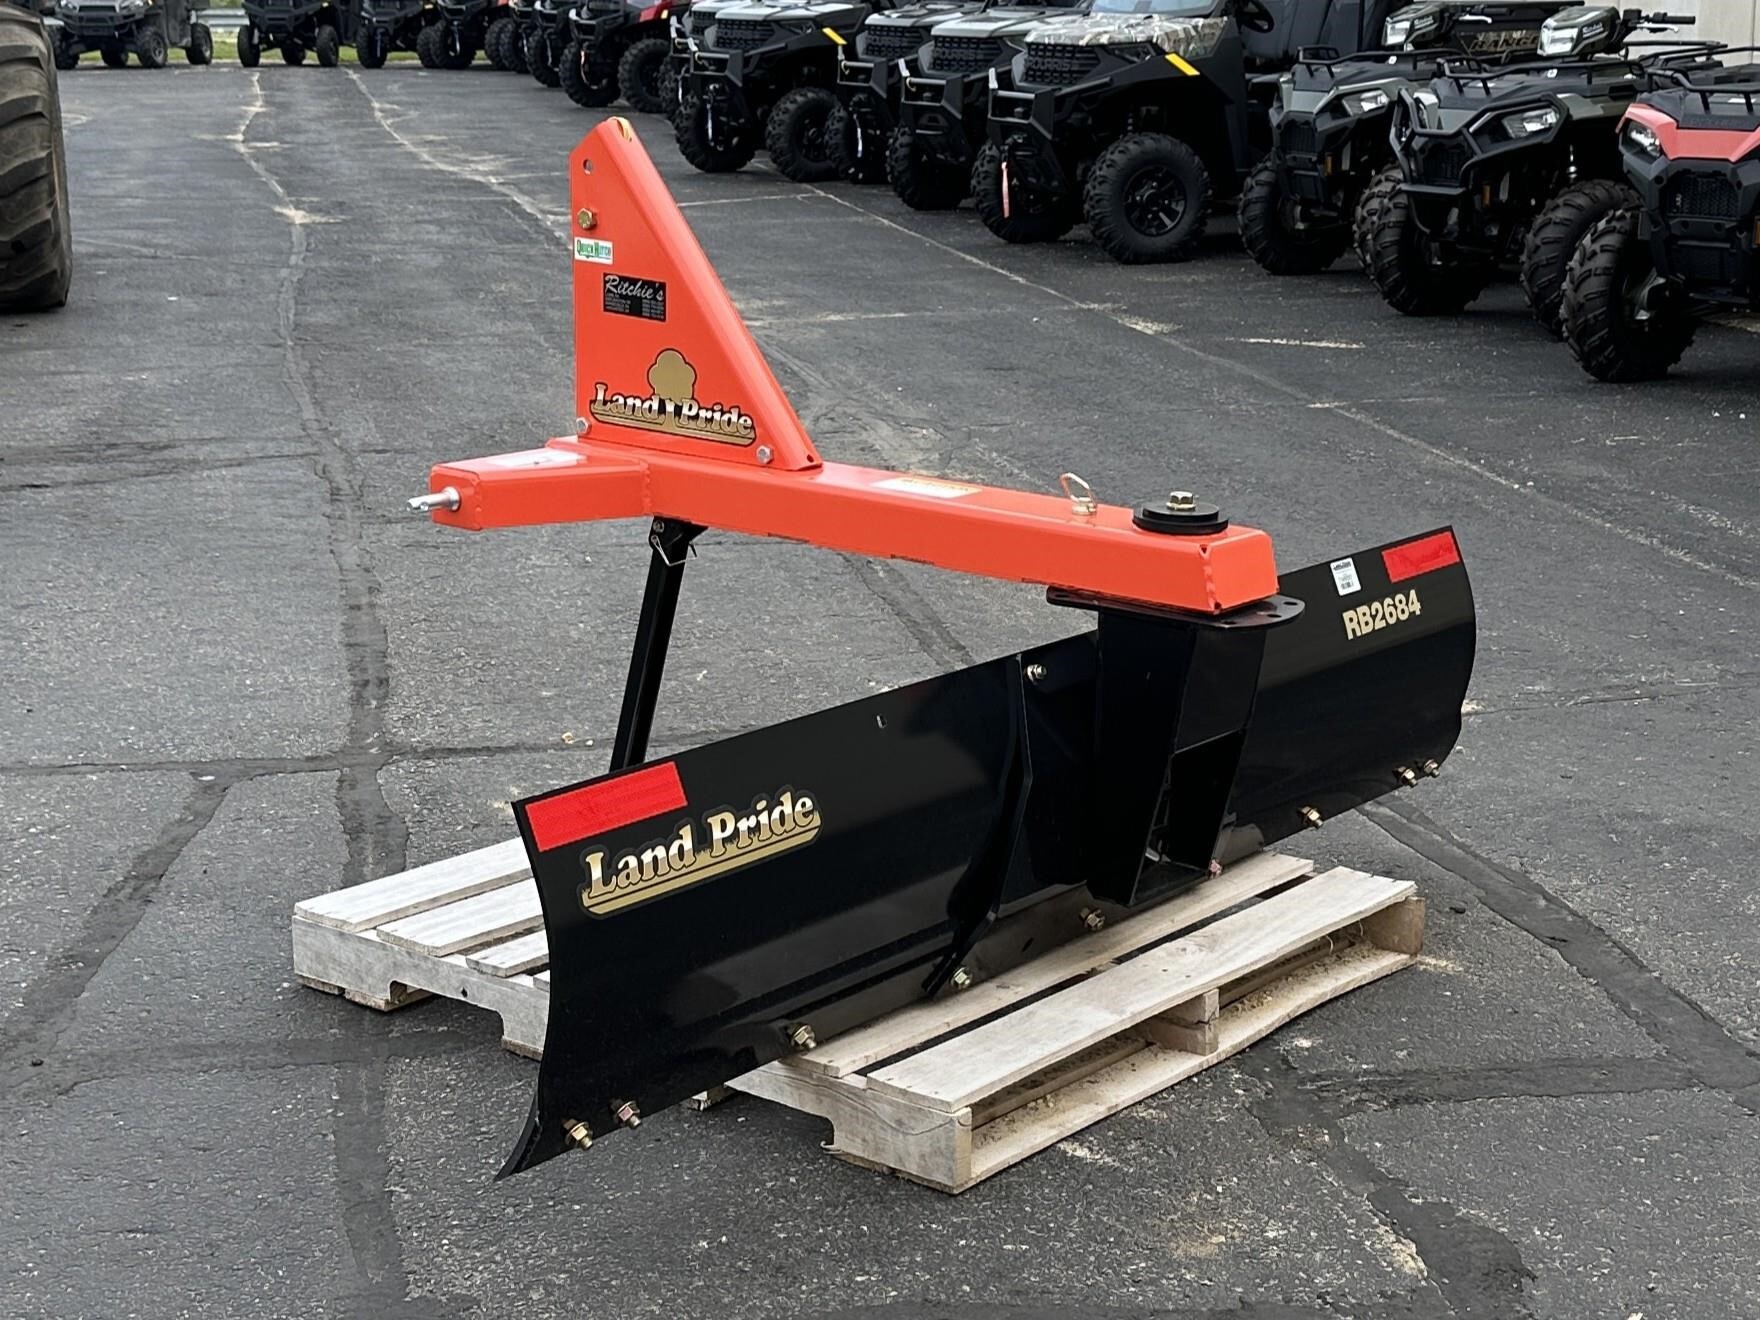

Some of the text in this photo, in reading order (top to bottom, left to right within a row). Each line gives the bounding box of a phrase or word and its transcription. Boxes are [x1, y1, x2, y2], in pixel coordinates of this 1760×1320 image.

[1471, 36, 1540, 50] RANGE
[604, 274, 664, 301] Ritchie's
[594, 384, 753, 435] Land Pride
[1342, 588, 1421, 640] RB2684
[585, 791, 815, 898] Land Pride
